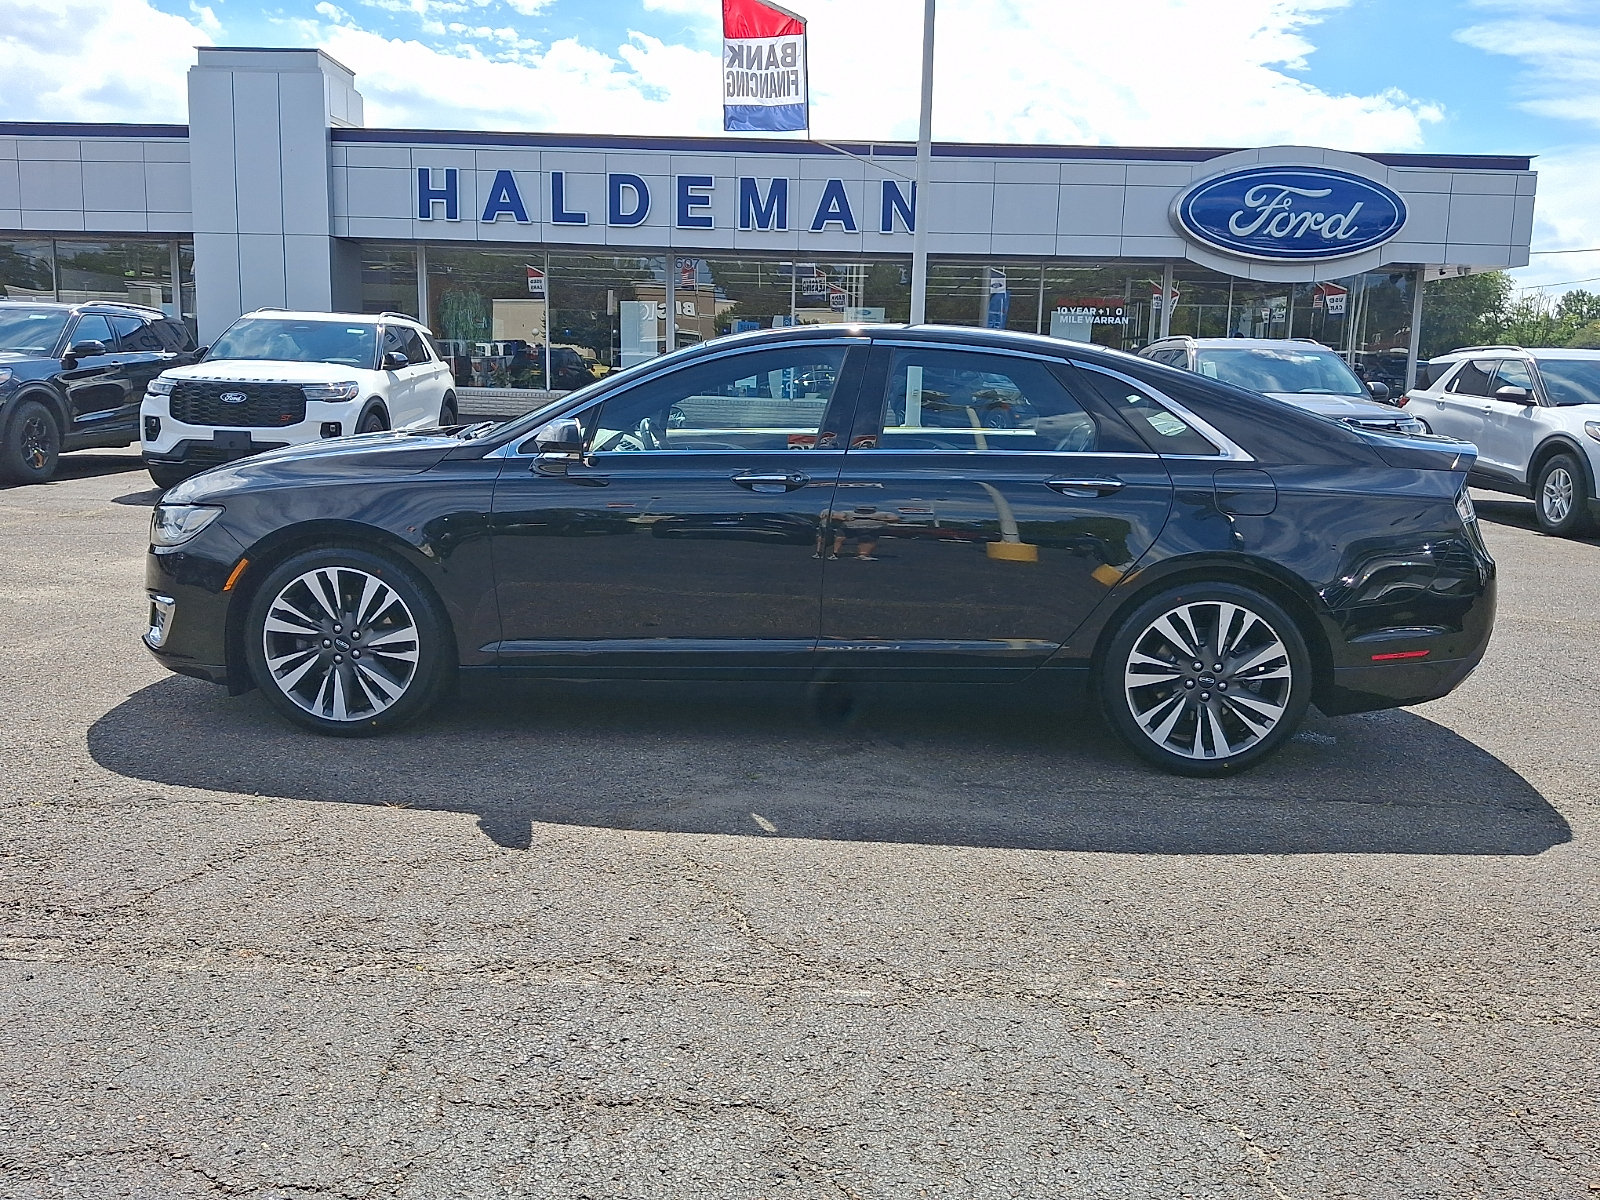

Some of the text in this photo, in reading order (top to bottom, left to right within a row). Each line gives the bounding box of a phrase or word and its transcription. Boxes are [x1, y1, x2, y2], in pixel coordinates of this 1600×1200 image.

[416, 166, 918, 235] HALDEMAN
[1229, 184, 1364, 239] Ford
[1057, 306, 1067, 315] 10
[1070, 306, 1096, 315] YEAR
[1059, 316, 1128, 324] MILE WARRAN
